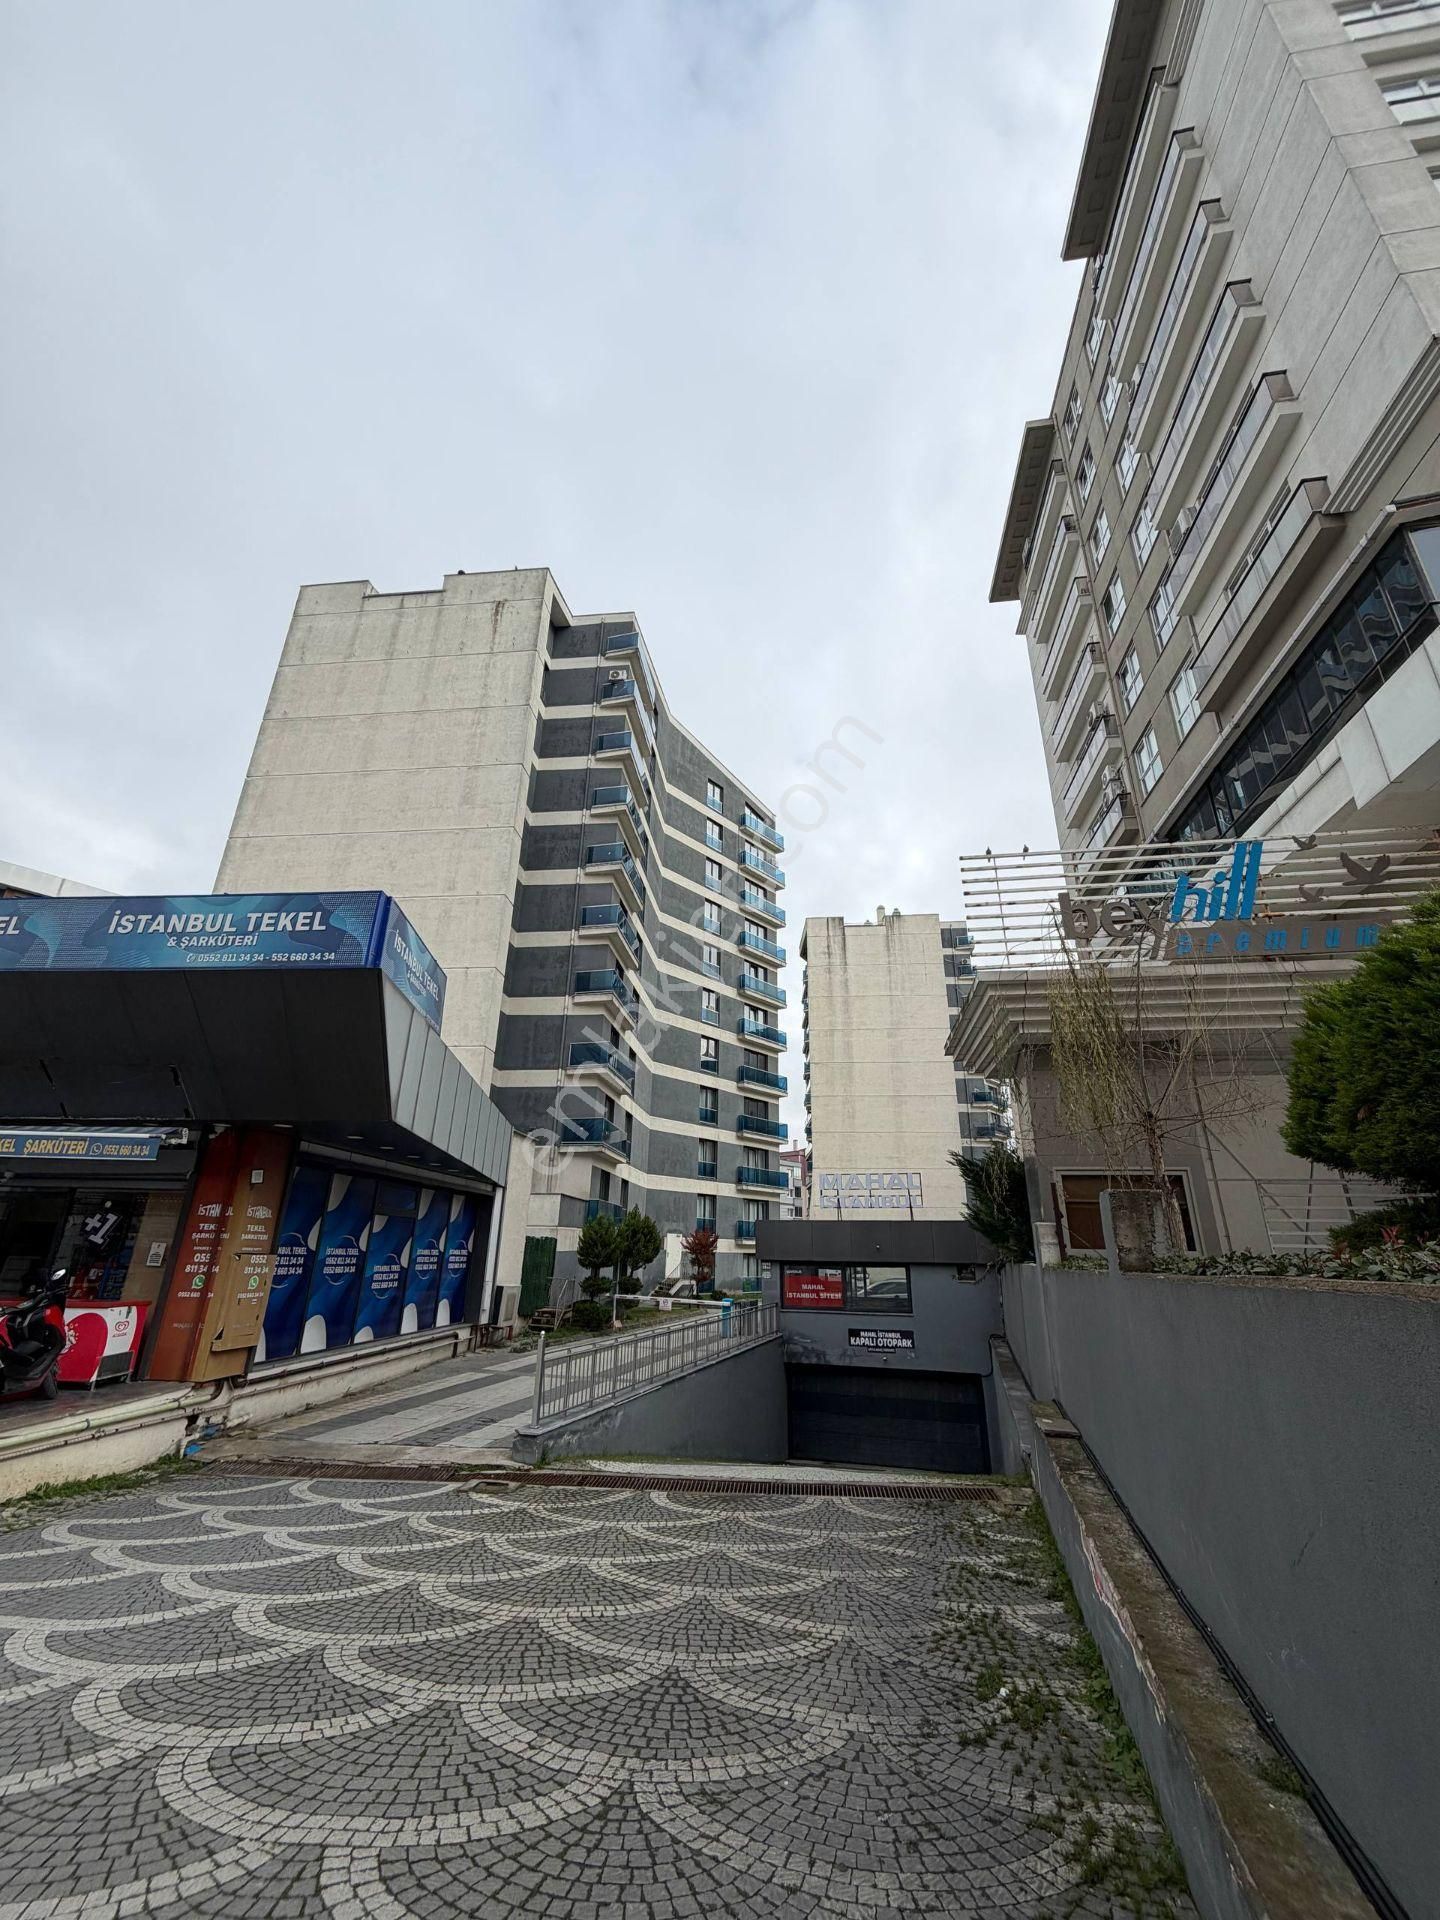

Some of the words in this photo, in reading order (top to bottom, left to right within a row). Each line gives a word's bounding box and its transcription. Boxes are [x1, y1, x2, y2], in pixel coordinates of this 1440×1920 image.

[108, 909, 237, 934] İSTANBUL
[246, 911, 327, 932] TEKEL
[167, 937, 177, 947] &
[180, 933, 259, 950] ŞARKÜTERİ
[1176, 923, 1381, 957] premium
[199, 953, 220, 962] 0552
[221, 953, 237, 962] 811
[239, 953, 251, 962] 34
[252, 953, 265, 962] 34
[271, 952, 288, 961] 552
[290, 952, 307, 961] 660
[308, 952, 321, 961] 34
[322, 952, 336, 961] 34
[394, 929, 423, 980] İSTANBUL
[423, 971, 439, 1001] TEKEL
[24, 1137, 89, 1155] ŞARKÜTERİ
[132, 1145, 141, 1156] 34
[141, 1145, 150, 1156] 34
[819, 1173, 921, 1190] MAHAL
[198, 1203, 234, 1217] İSTANUL
[194, 1252, 211, 1263] 055
[250, 1255, 267, 1263] 0552
[786, 1290, 818, 1299] İSTANBUL
[877, 1338, 913, 1348] OTOPARK
